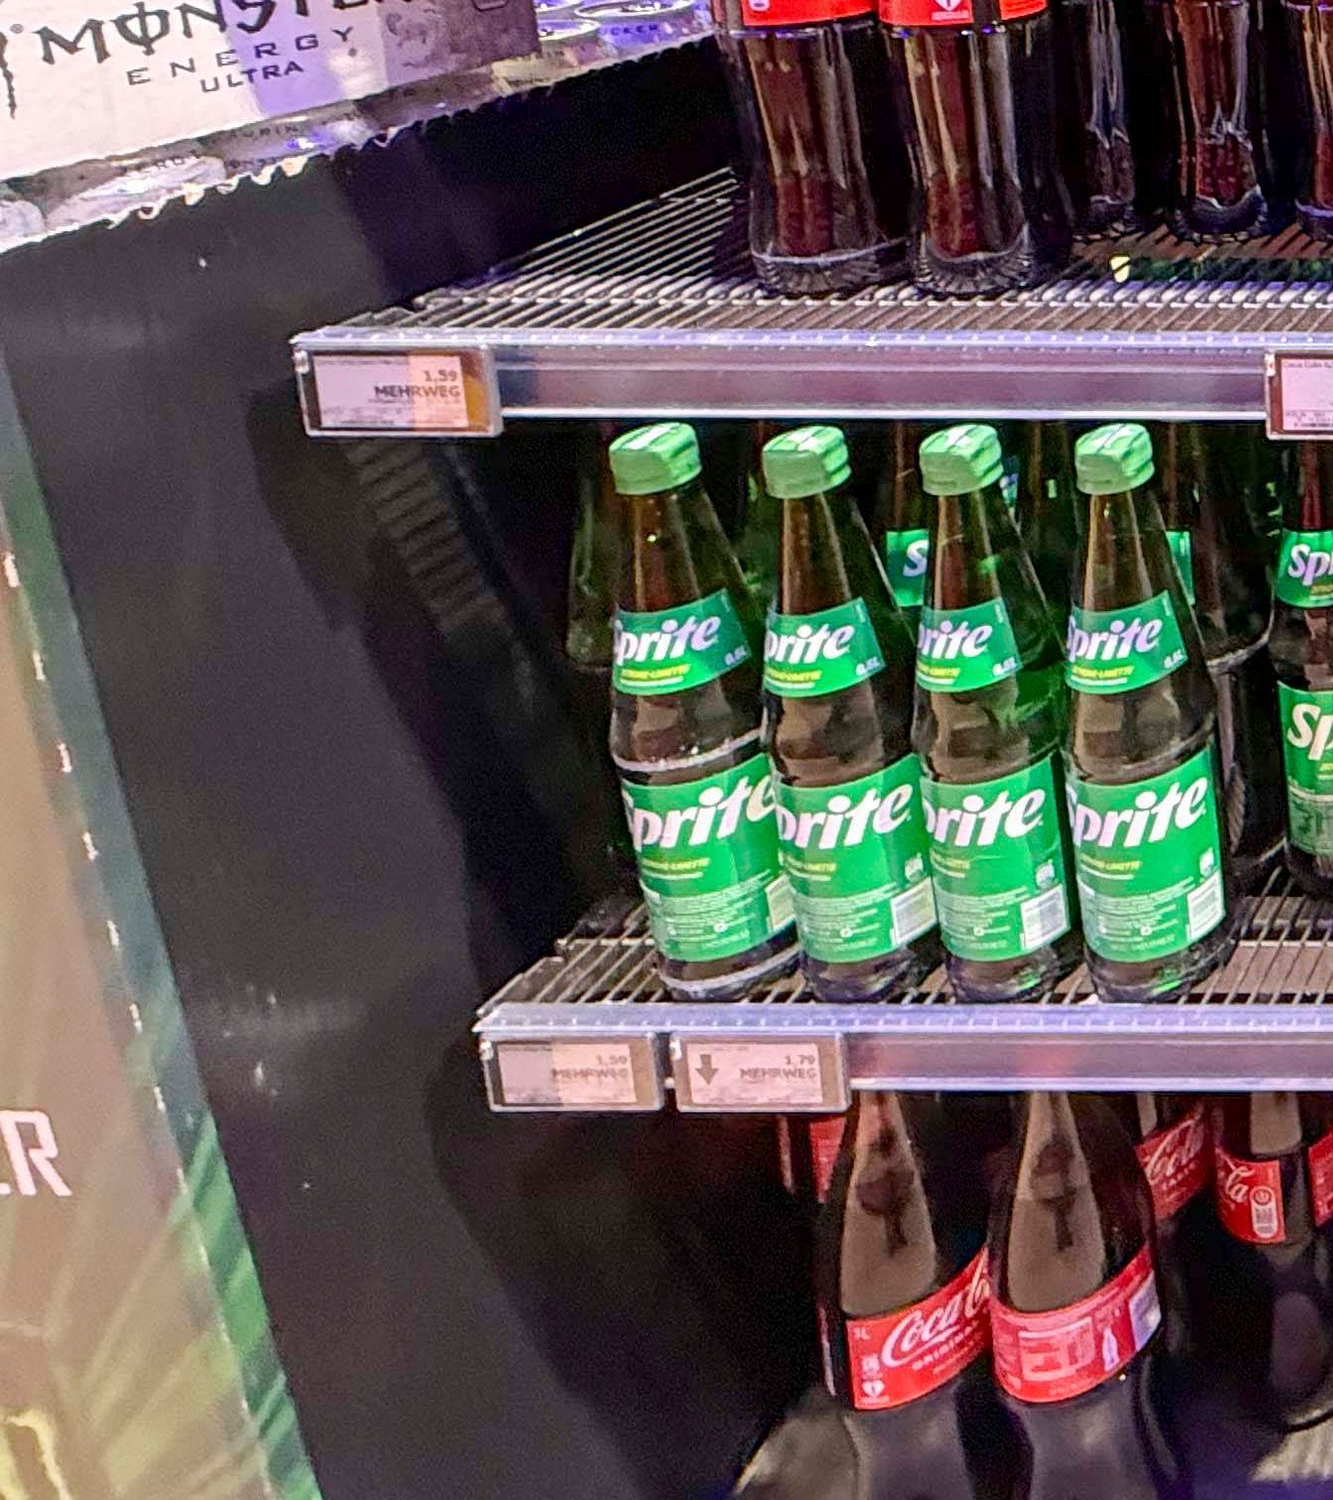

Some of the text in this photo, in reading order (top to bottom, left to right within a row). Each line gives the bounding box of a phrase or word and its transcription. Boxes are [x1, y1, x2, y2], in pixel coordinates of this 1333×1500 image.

[126, 25, 356, 88] ENERGY
[200, 60, 305, 94] ULTRA
[423, 369, 458, 383] 1,59
[373, 385, 462, 398] MEHRWEG
[765, 623, 855, 666] prite
[551, 1067, 630, 1081] MEHRWEG
[739, 1067, 818, 1080] MEHRWEG
